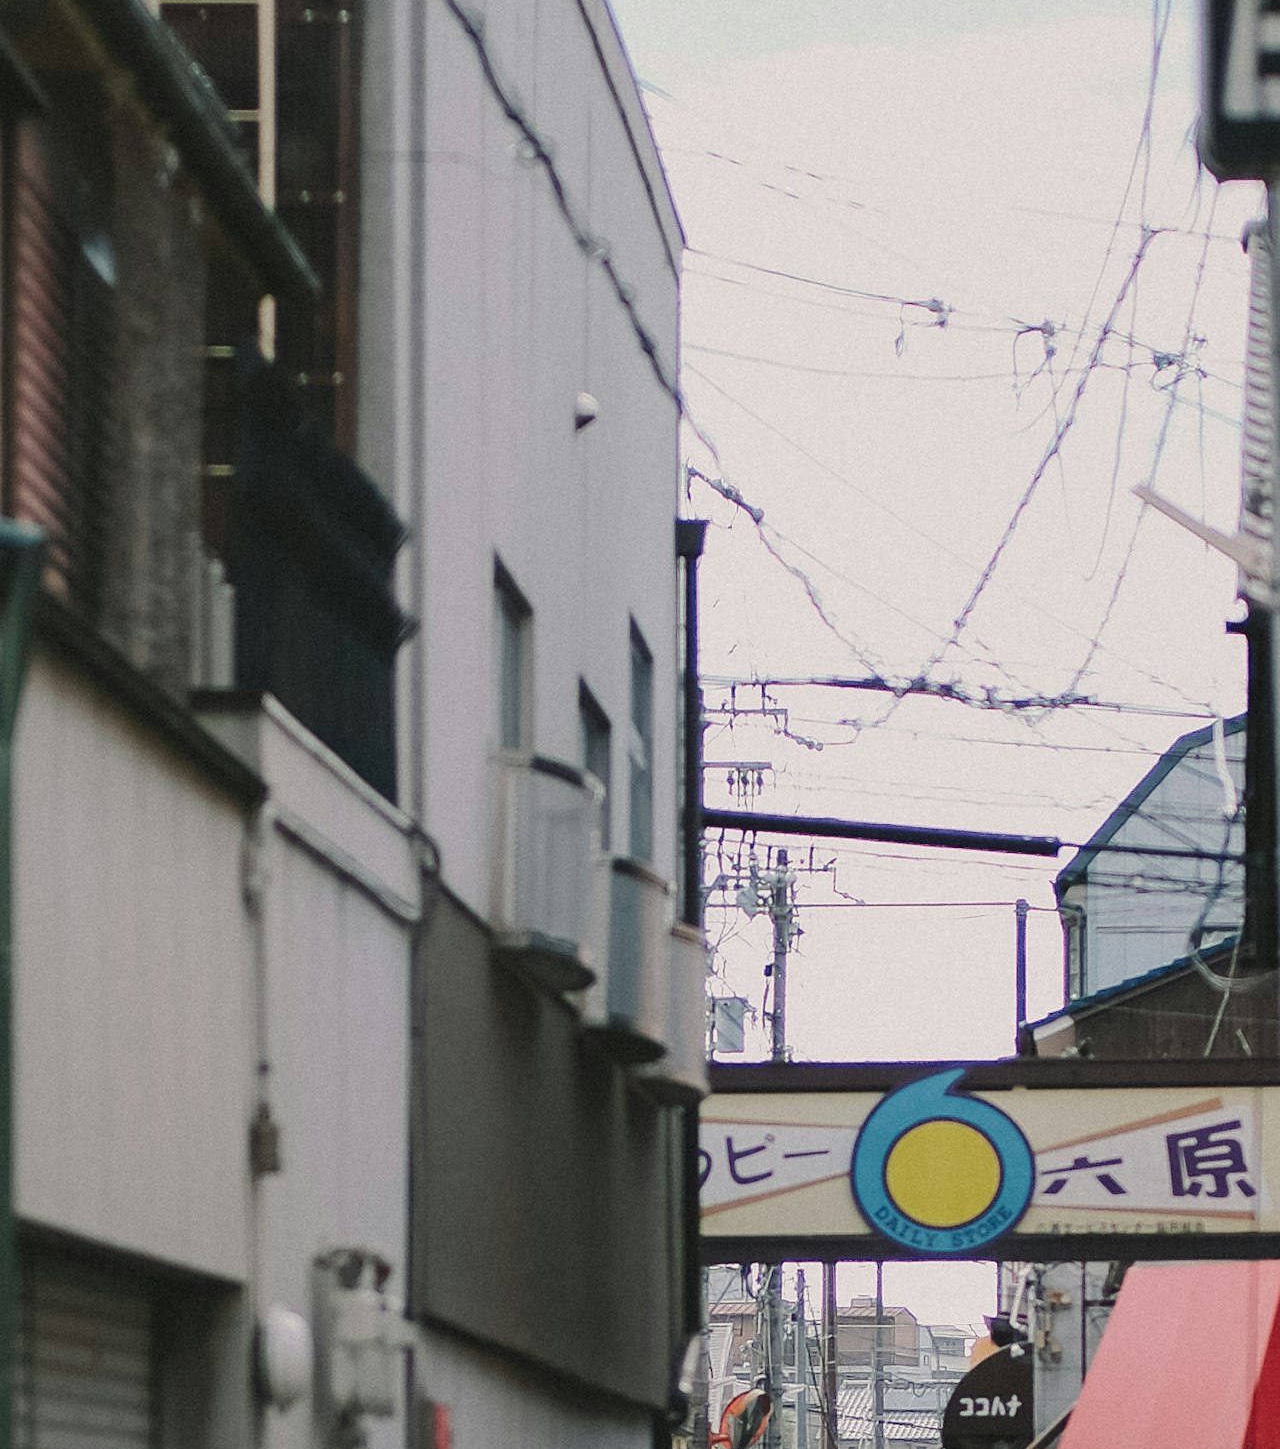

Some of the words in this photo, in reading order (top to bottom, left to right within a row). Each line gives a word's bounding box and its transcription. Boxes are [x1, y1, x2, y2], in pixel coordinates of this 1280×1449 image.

[1040, 1119, 1256, 1198] 六原
[873, 1206, 939, 1247] DAILY
[951, 1206, 1014, 1247] STORE
[959, 1394, 1022, 1418] ココハナ
